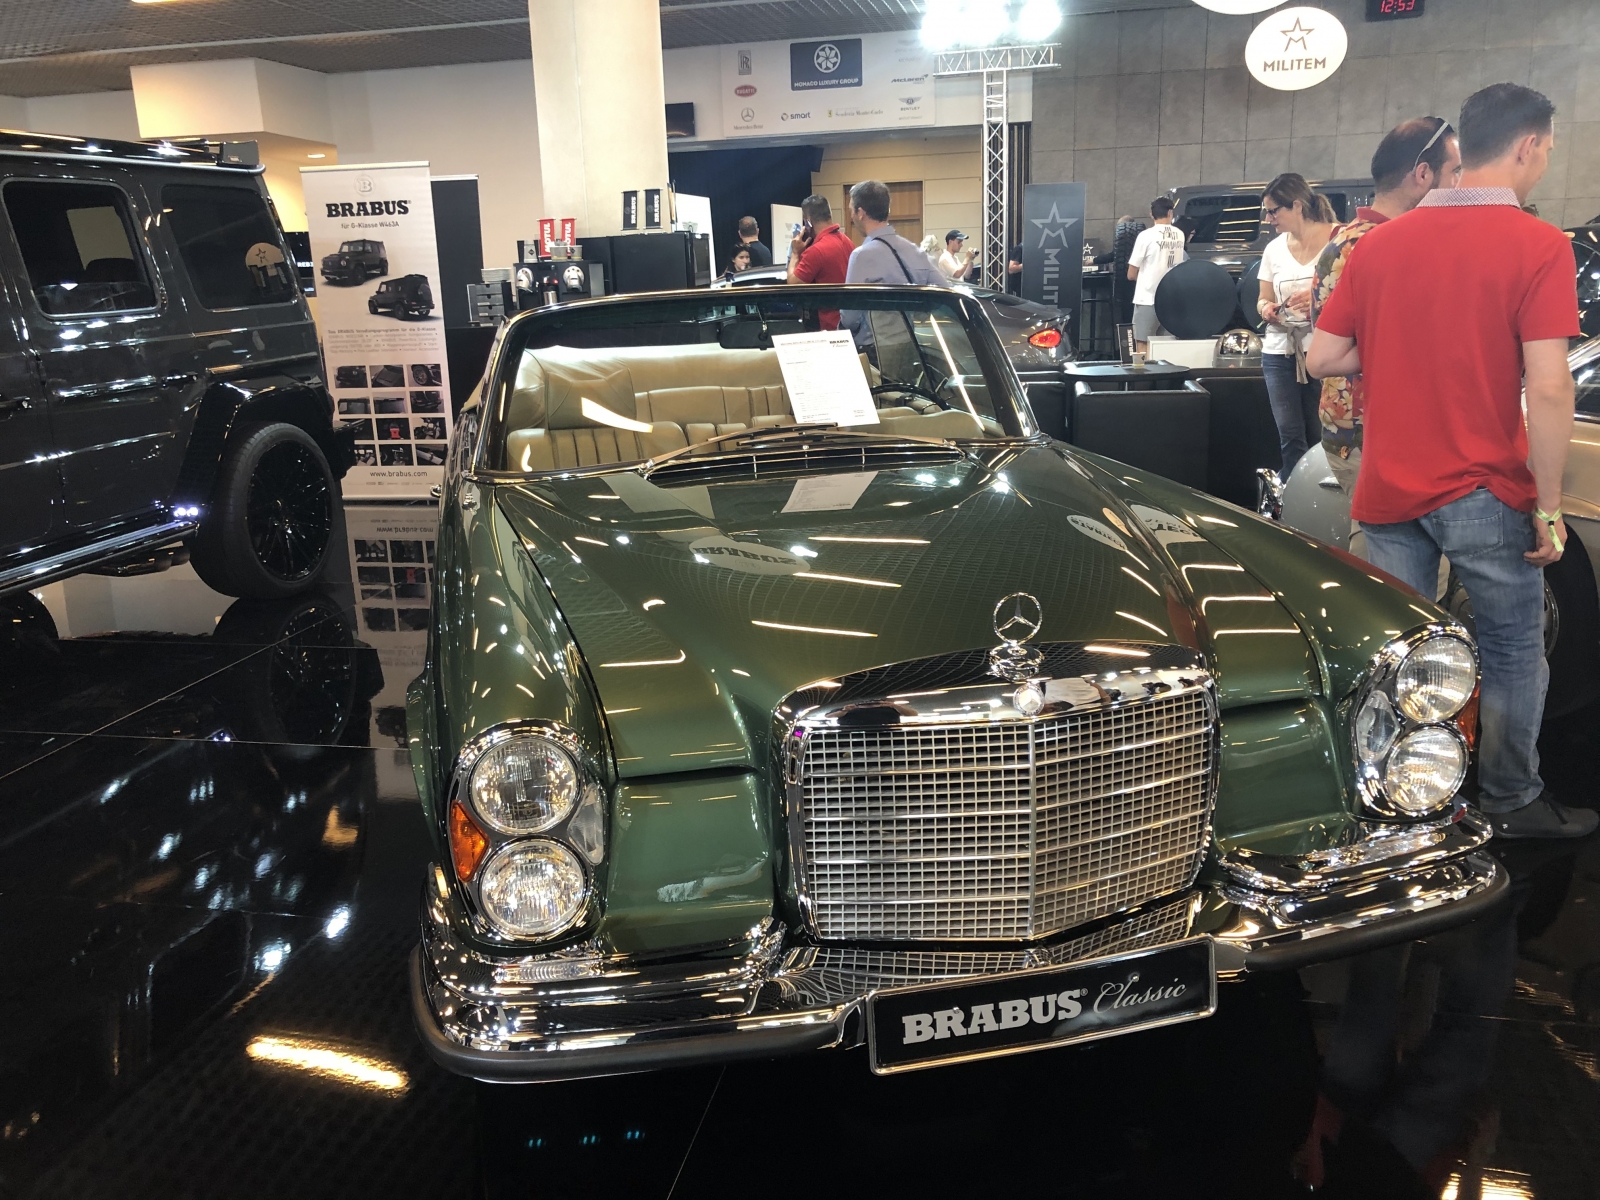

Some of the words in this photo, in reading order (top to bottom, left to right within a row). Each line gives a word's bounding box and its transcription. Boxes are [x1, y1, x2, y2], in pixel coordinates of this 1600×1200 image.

[1380, 0, 1415, 13] 12:53
[1263, 57, 1327, 72] MILITEM
[325, 199, 411, 218] BRABUS
[543, 222, 551, 253] MOTUL
[1092, 977, 1188, 1015] Classic
